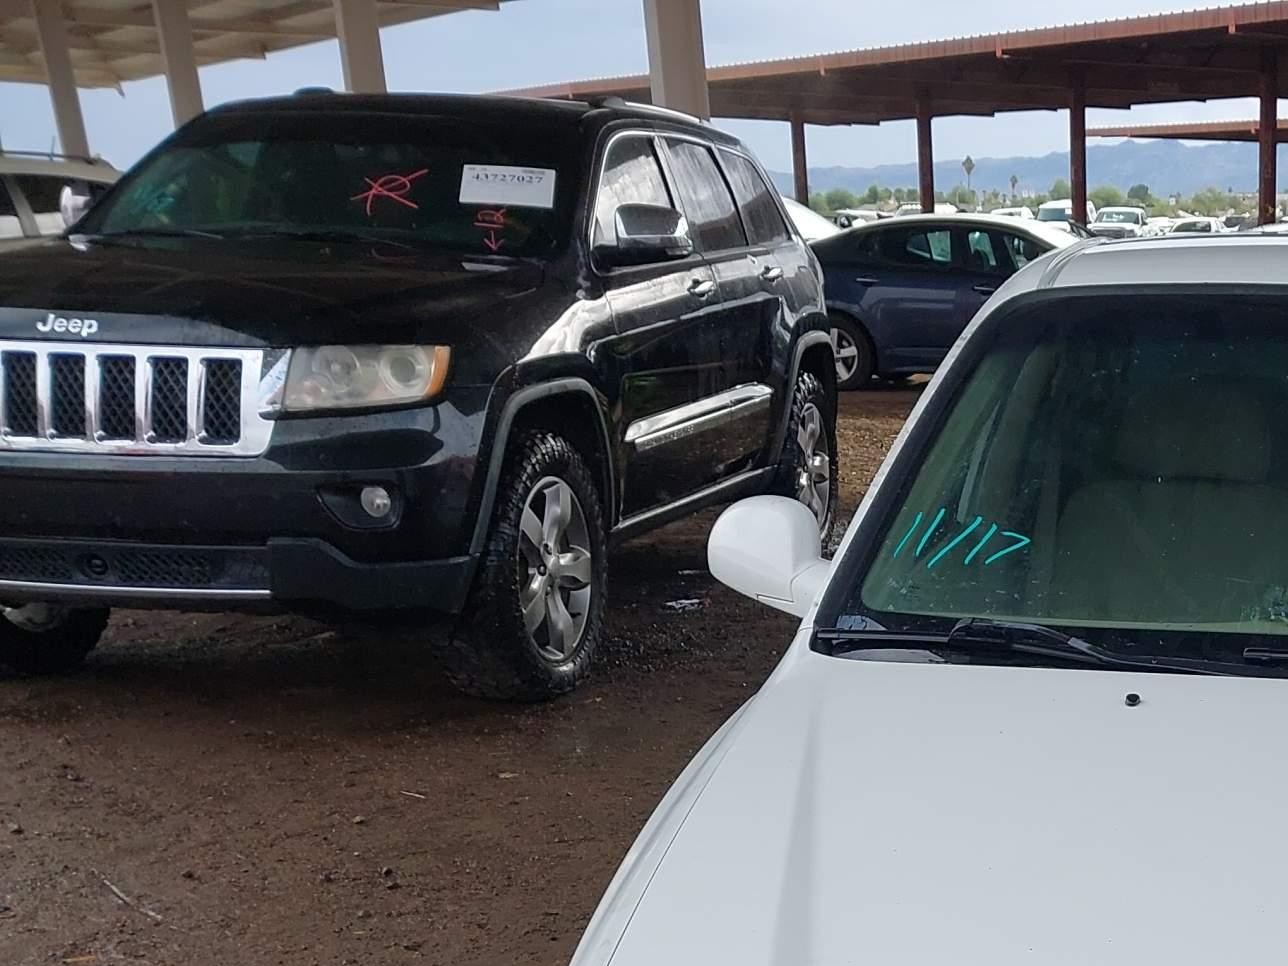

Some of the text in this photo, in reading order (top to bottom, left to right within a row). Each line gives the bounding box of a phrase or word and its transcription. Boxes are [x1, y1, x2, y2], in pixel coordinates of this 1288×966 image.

[471, 172, 544, 185] 43727027
[36, 313, 98, 337] Jeep
[893, 508, 1031, 569] 11/17
